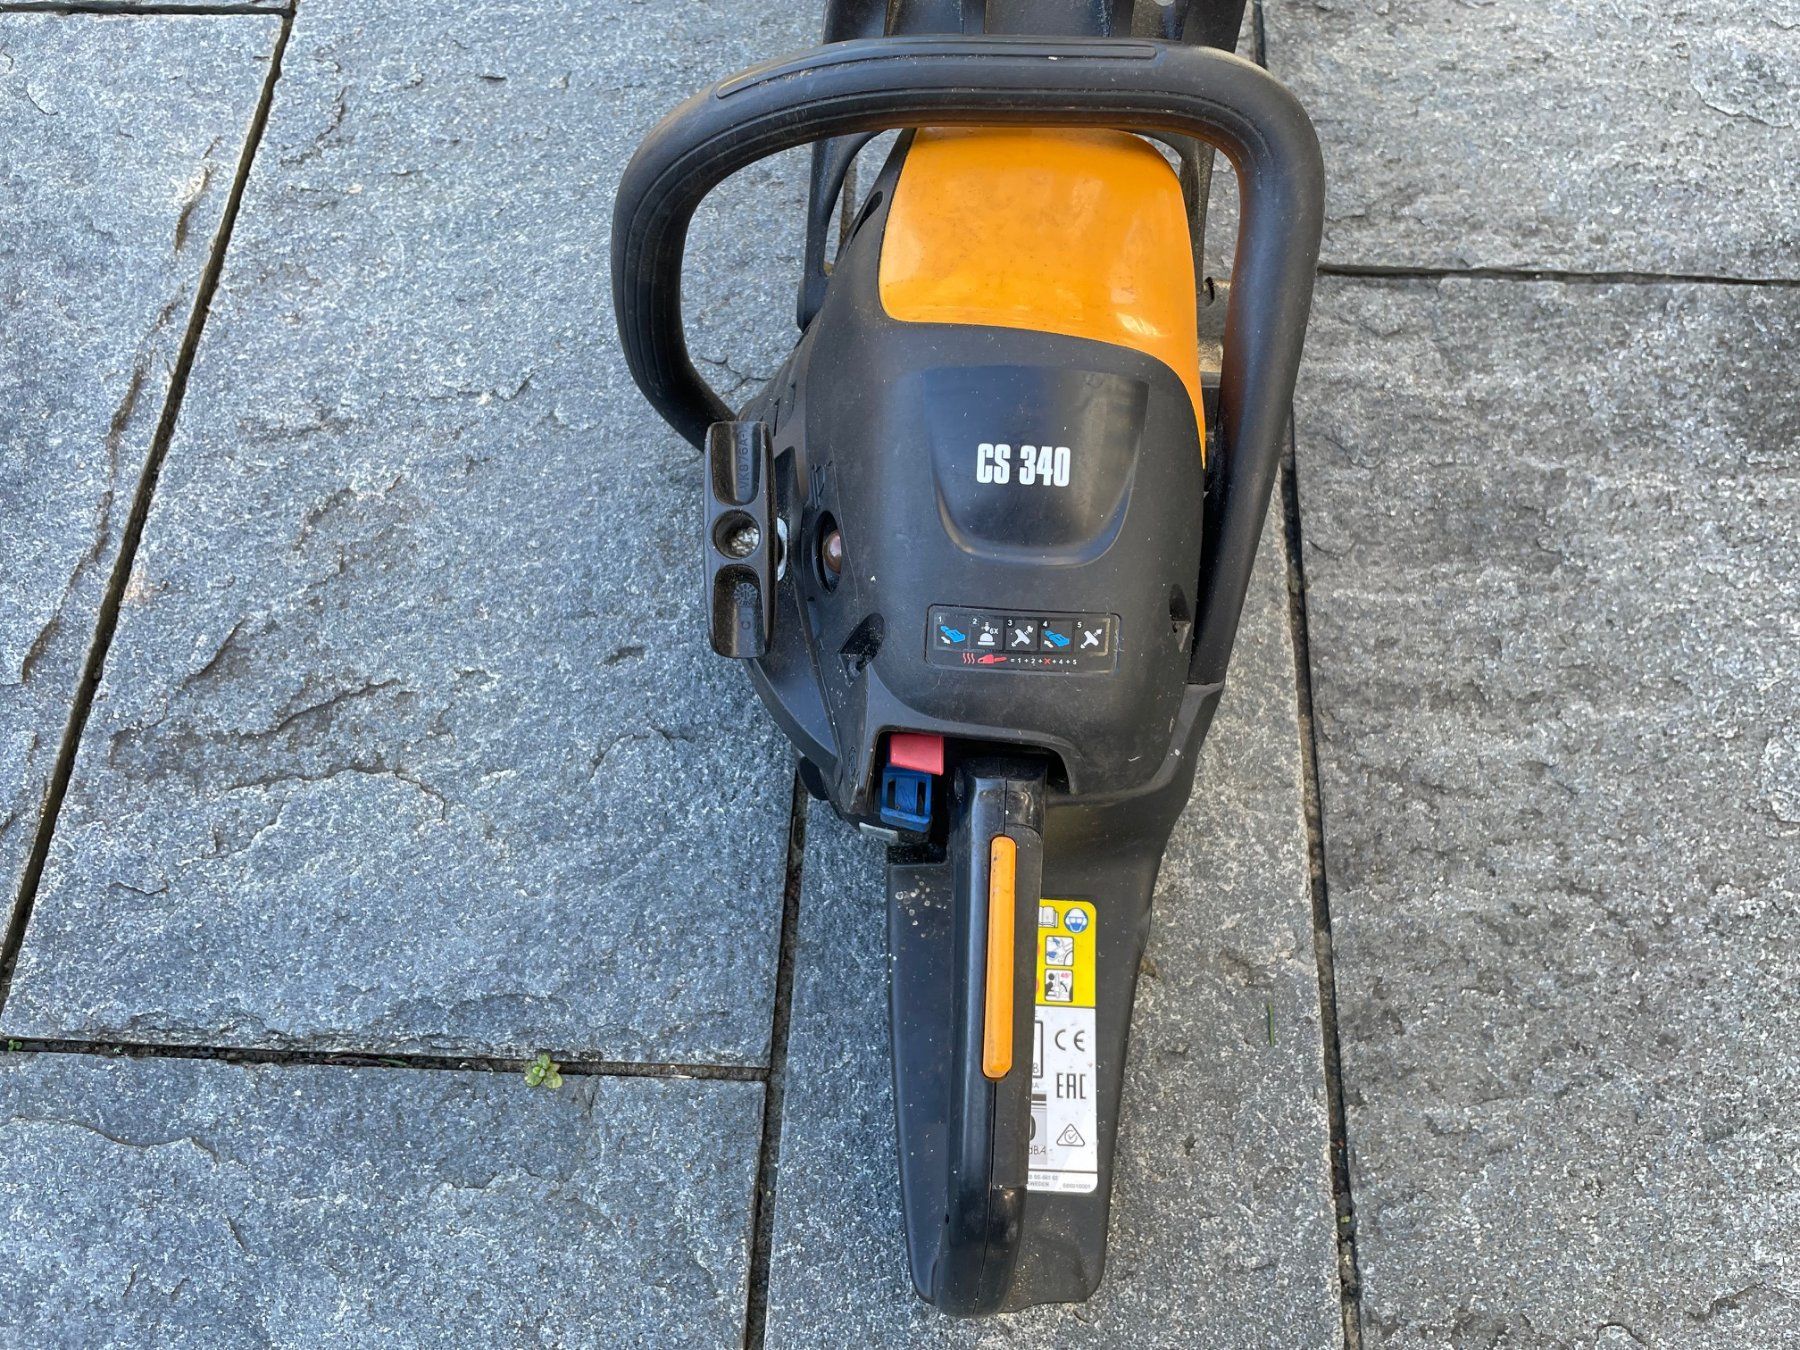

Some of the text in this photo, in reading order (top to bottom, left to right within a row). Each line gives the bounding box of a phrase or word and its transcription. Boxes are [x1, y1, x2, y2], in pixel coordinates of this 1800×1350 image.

[976, 443, 1071, 487] CS 340
[1055, 1029, 1085, 1052] CE
[1056, 1073, 1086, 1099] EAC
